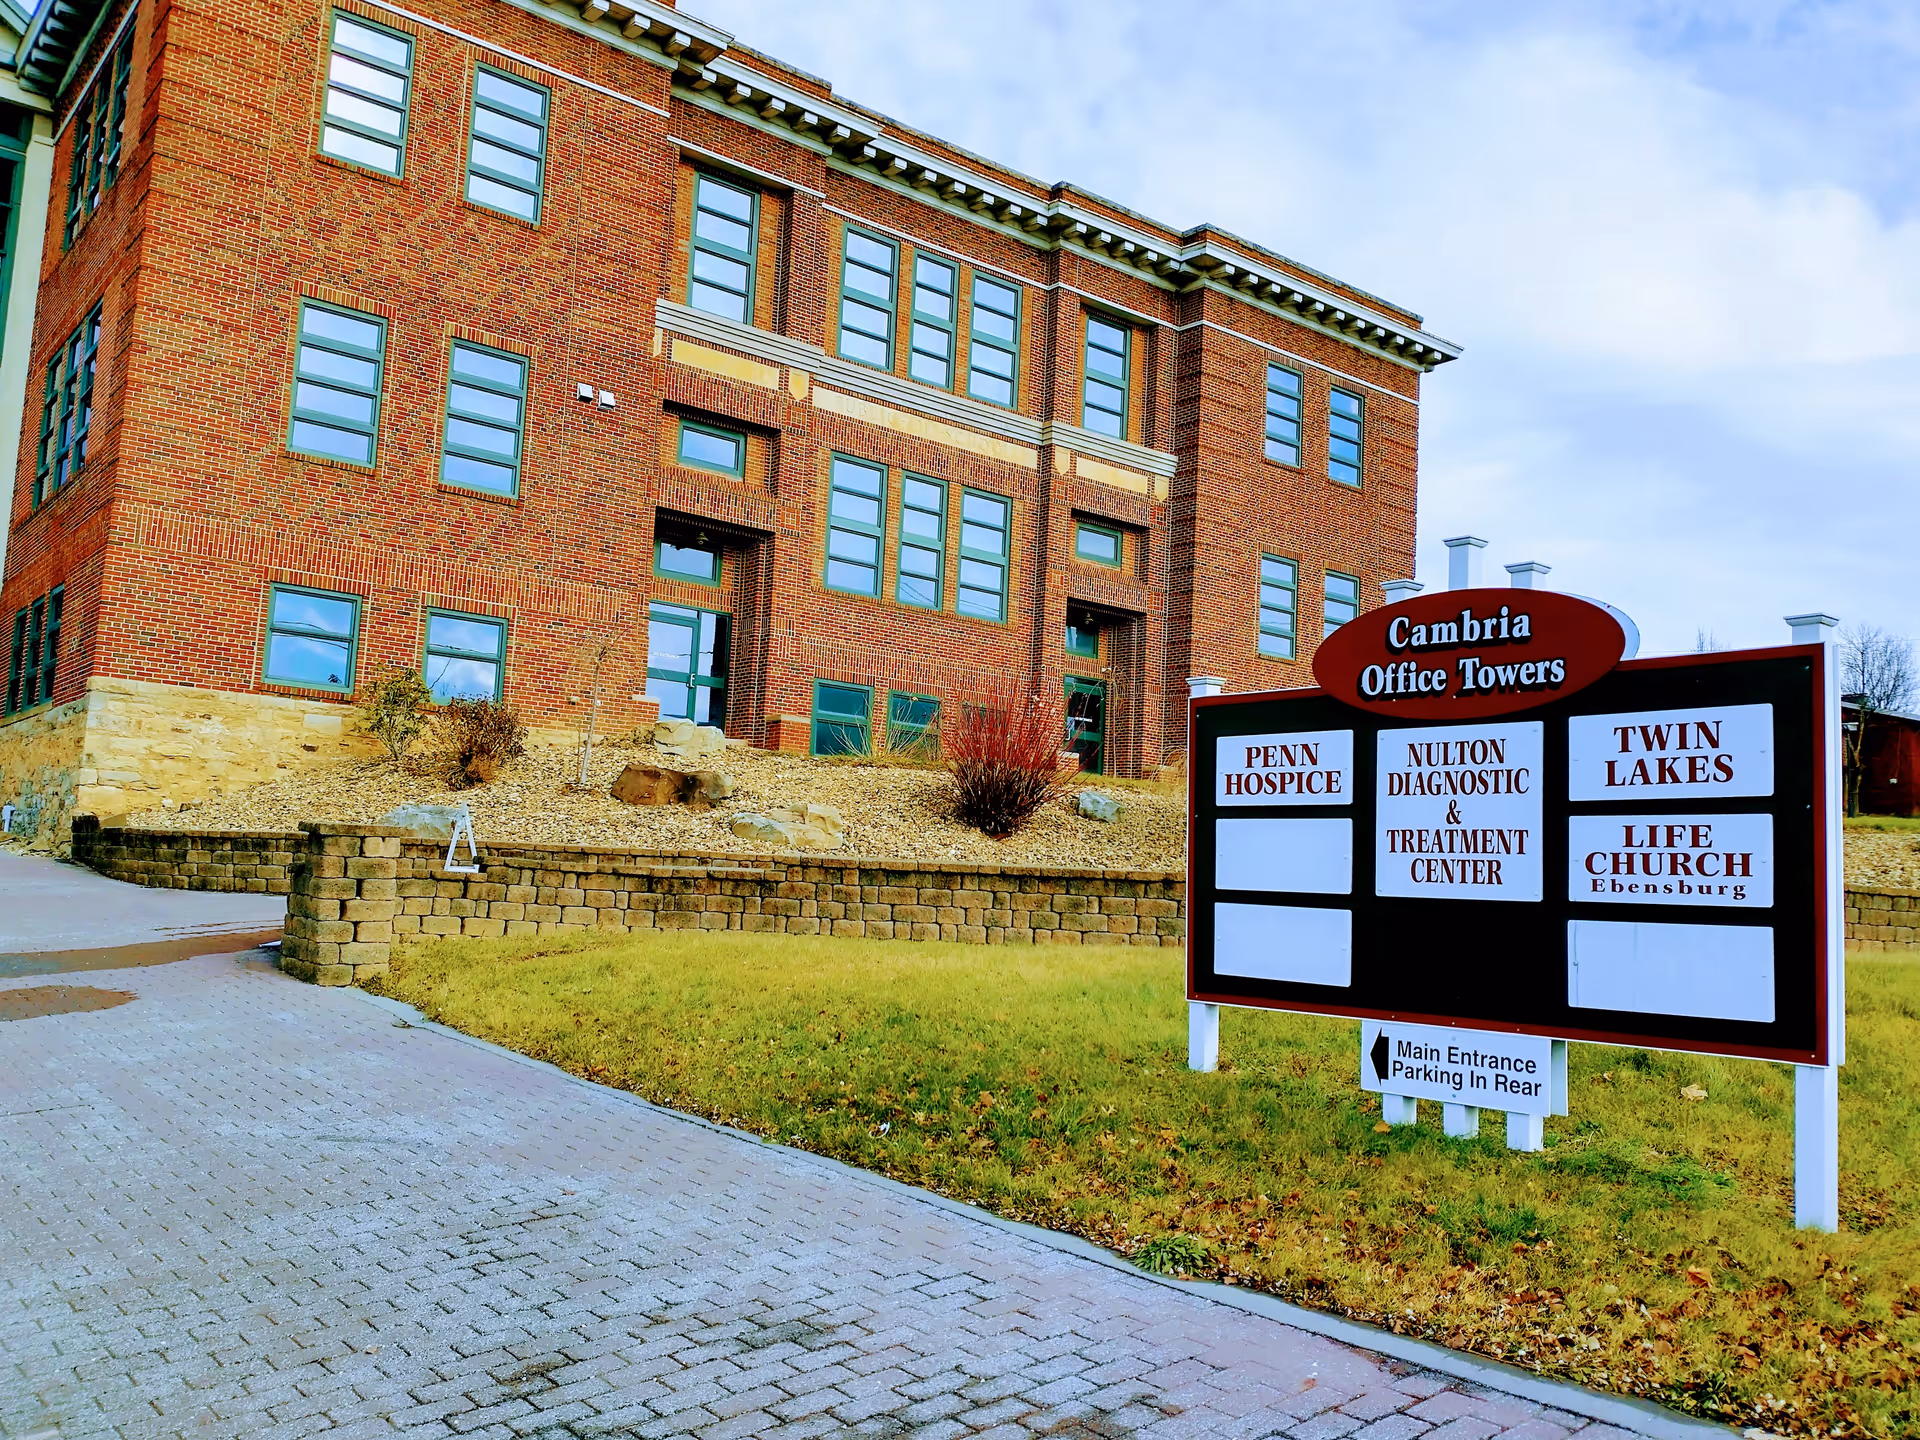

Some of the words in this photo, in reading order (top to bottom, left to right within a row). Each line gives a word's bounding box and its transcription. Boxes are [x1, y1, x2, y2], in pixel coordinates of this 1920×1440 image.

[1389, 606, 1530, 648] Cambria
[1361, 661, 1447, 696] Office
[1459, 657, 1565, 690] Towers
[1613, 720, 1722, 753] TWIN
[1245, 743, 1320, 768] PENN
[1407, 738, 1506, 767] NULTON
[1225, 770, 1341, 795] HOSPICE
[1388, 768, 1530, 796] DIAGNOSTIC
[1605, 754, 1734, 786] LAKES
[1446, 799, 1462, 825] &
[1386, 829, 1529, 855] TREATMENT
[1622, 825, 1713, 848] LIFE
[1411, 858, 1503, 885] CENTER
[1585, 852, 1753, 877] CHURCH
[1591, 878, 1746, 900] Ebensburg
[1397, 1040, 1440, 1062] Main
[1448, 1046, 1537, 1074] Entrance
[1392, 1060, 1463, 1090] Parking
[1470, 1070, 1487, 1089] In
[1495, 1073, 1542, 1097] Rear
